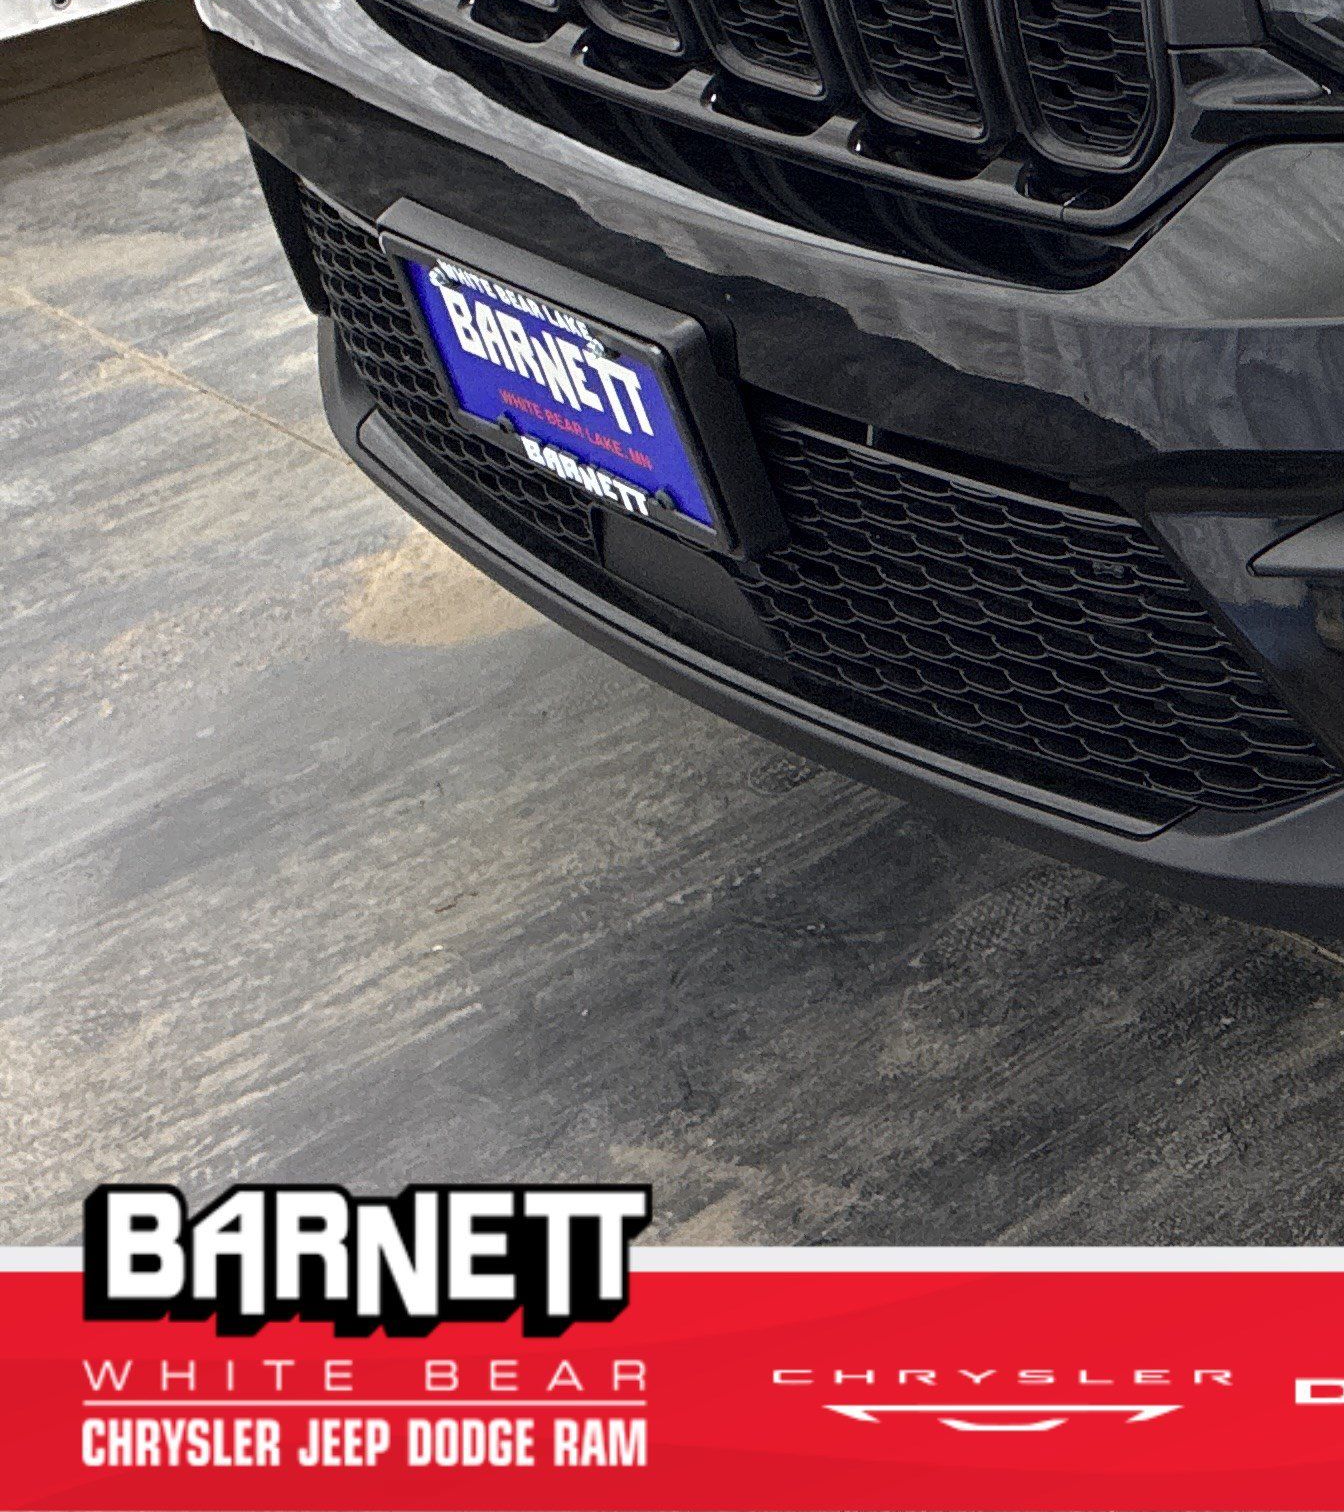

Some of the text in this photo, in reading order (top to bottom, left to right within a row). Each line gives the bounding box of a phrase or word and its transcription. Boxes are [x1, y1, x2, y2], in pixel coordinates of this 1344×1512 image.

[493, 284, 546, 321] BEAR
[541, 304, 592, 341] LAKE
[439, 286, 655, 437] BARNETT
[500, 388, 546, 421] WHITE
[544, 409, 583, 436] BEAR
[520, 435, 649, 516] BARNETT
